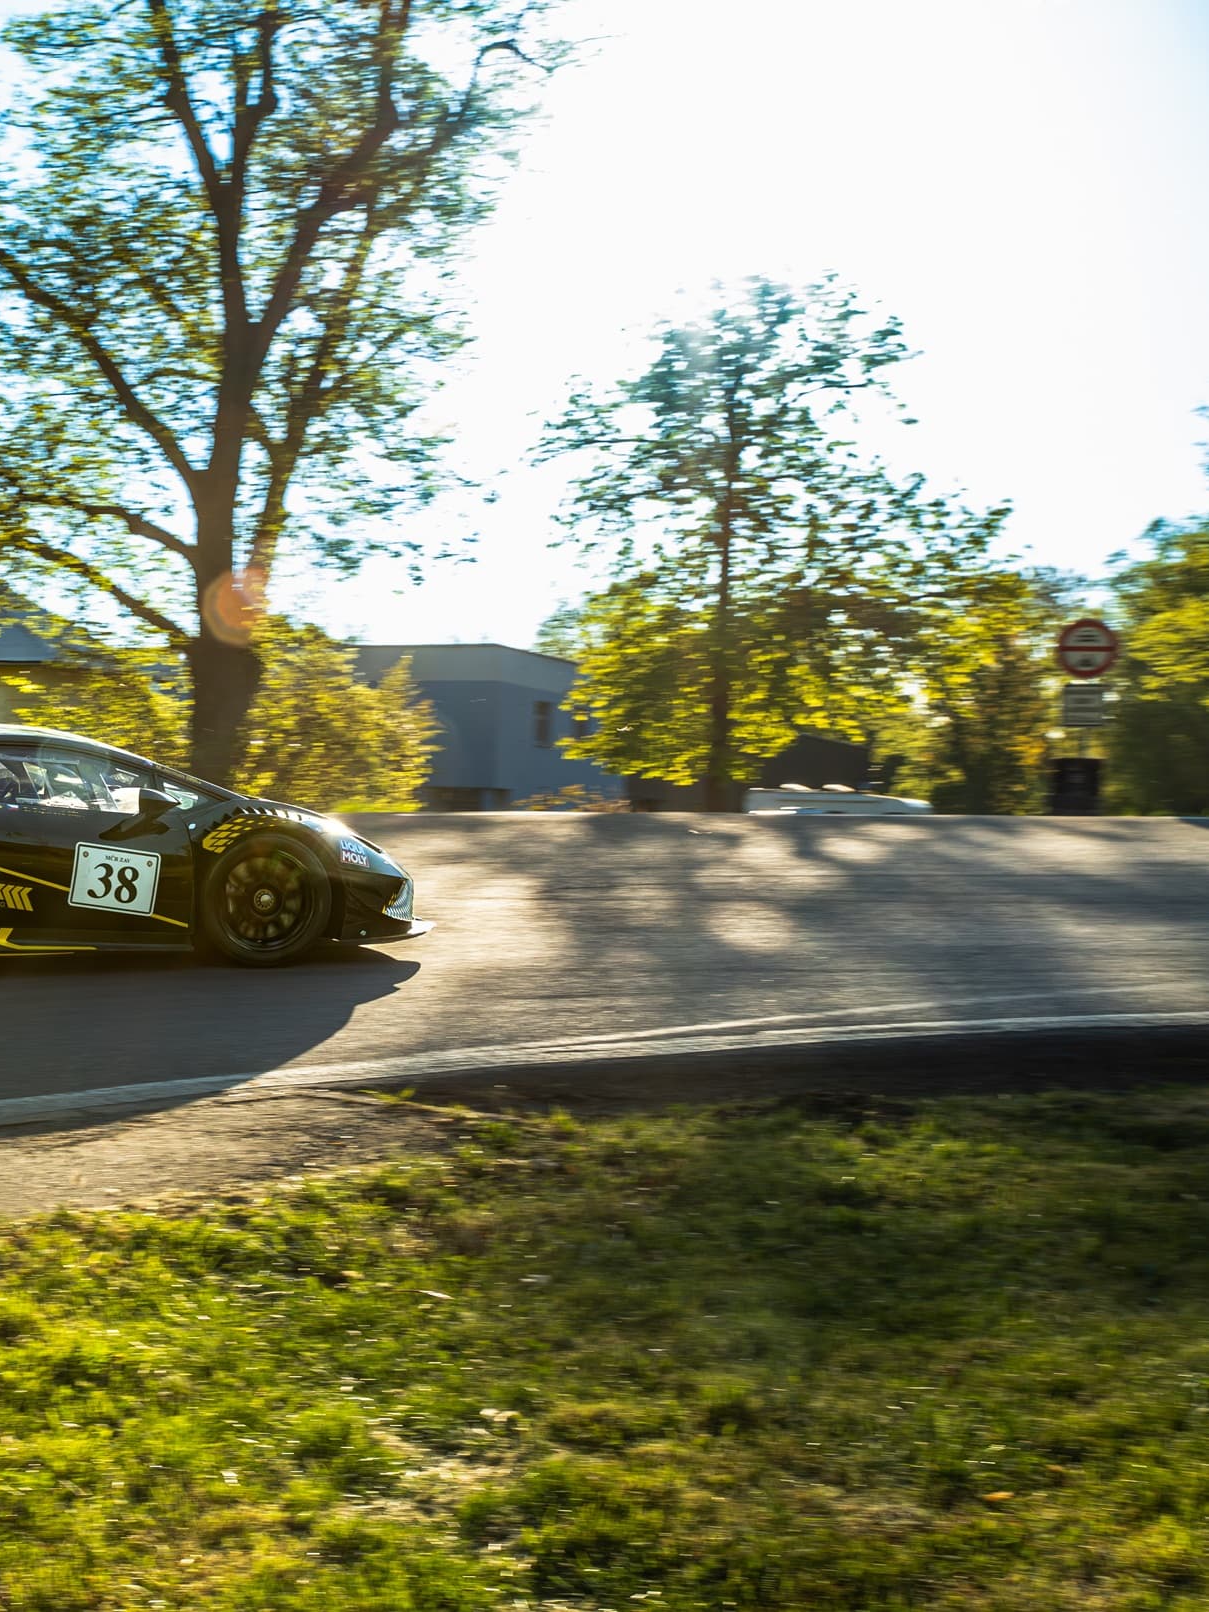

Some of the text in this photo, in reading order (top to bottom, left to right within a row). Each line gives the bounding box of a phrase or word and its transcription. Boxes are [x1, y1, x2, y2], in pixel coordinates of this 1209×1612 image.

[340, 839, 365, 855] LIQUI
[342, 851, 368, 866] MOLY
[87, 862, 140, 904] 38
